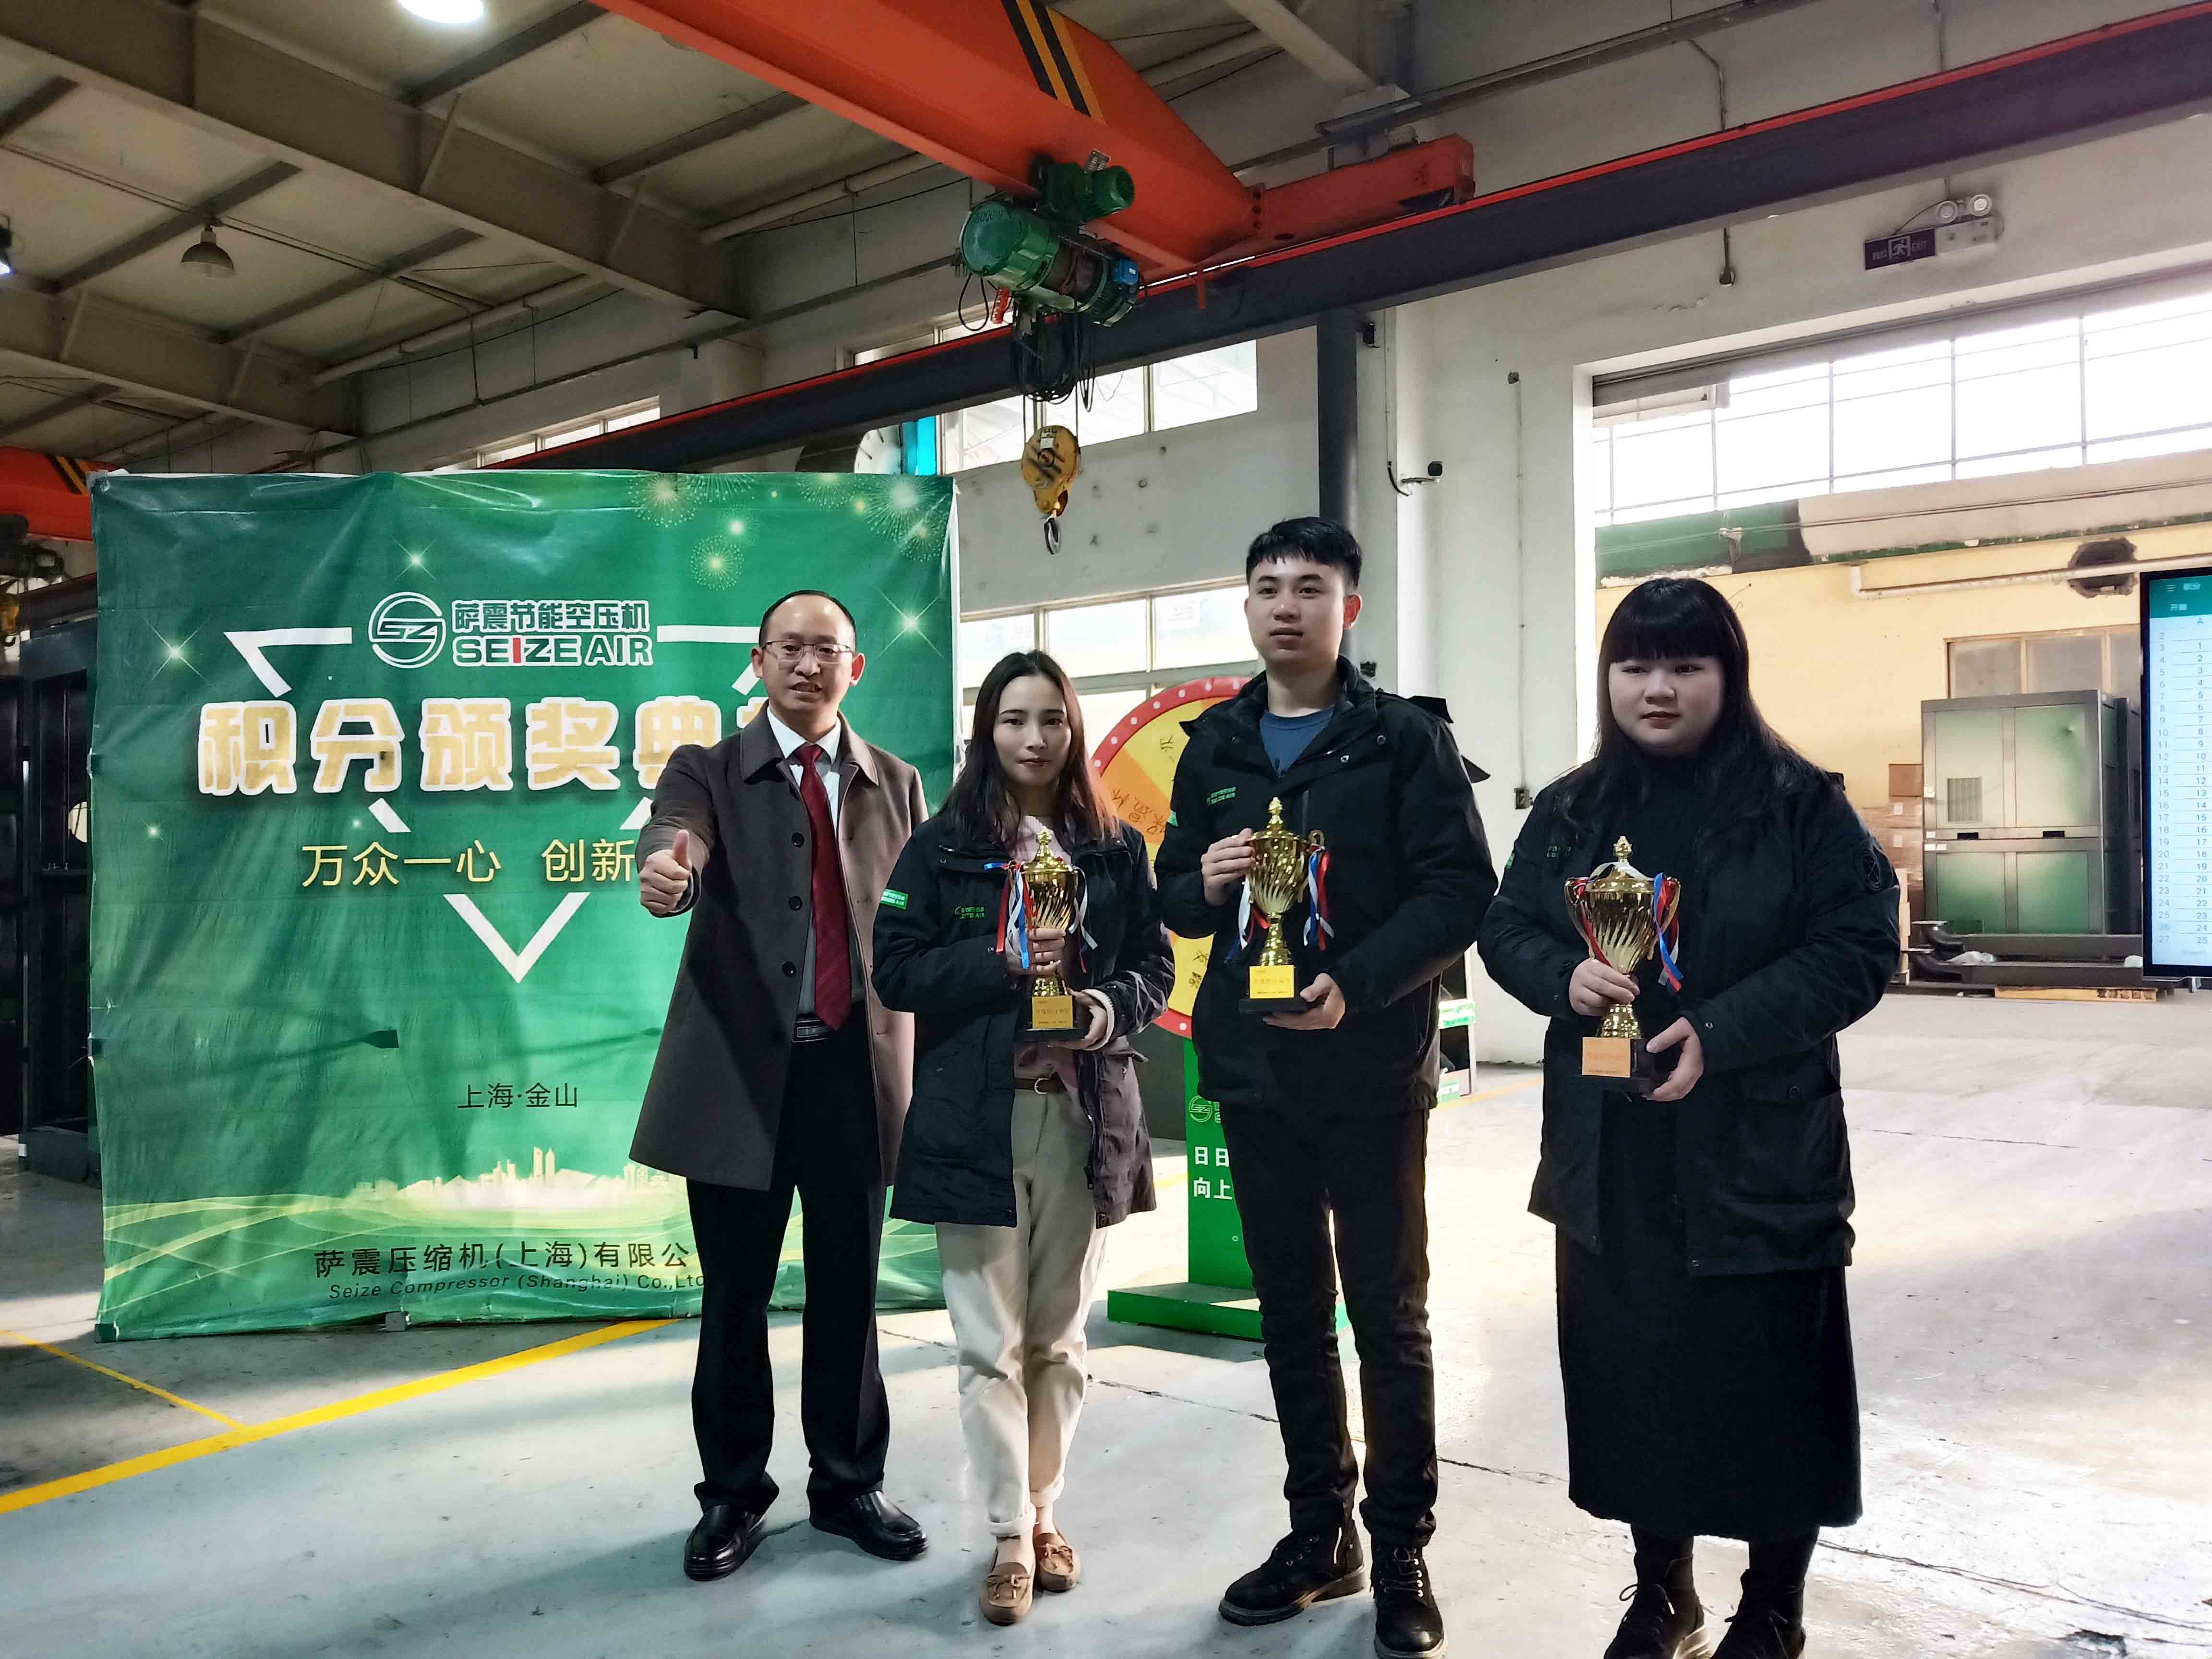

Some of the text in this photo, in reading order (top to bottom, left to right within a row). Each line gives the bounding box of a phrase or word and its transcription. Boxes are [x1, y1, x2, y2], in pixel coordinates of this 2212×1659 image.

[453, 600, 649, 632] 萨震节能空压机
[453, 635, 653, 666] SEIZE AIR
[198, 696, 769, 795] 积分颁奖典
[301, 839, 636, 887] 万众一心 创新
[1193, 1177, 1233, 1200] 向上
[329, 1282, 381, 1299] Seize
[390, 1274, 510, 1296] Compressor
[518, 1274, 628, 1292] (Shanghai)
